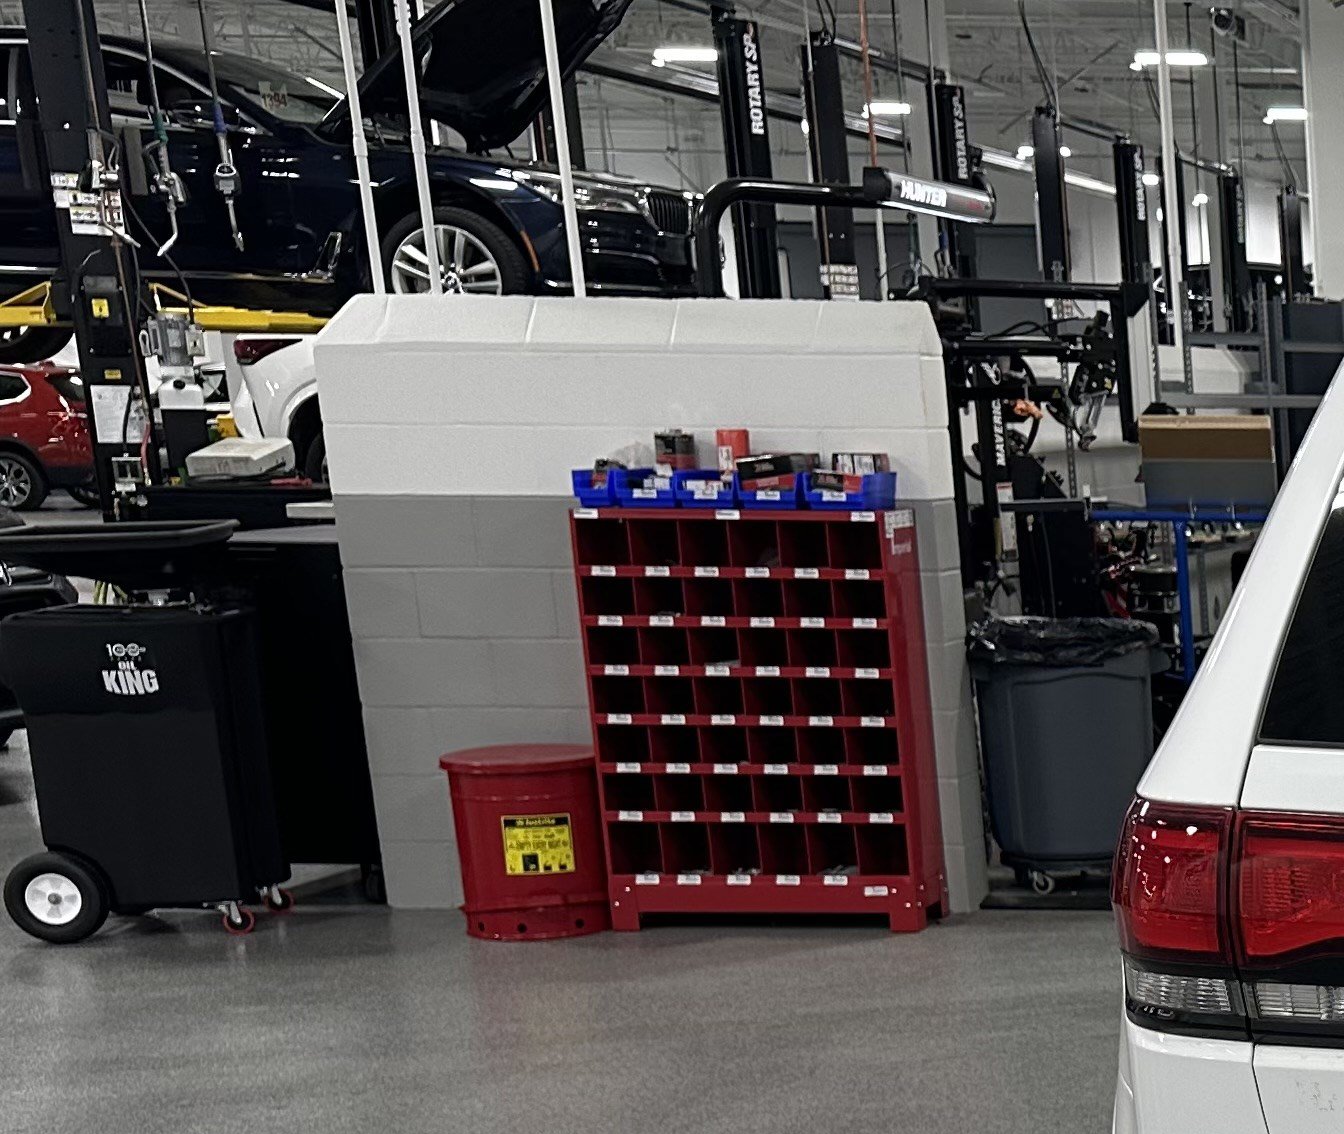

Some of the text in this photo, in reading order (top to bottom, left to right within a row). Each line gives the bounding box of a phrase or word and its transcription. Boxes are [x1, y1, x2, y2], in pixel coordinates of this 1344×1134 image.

[746, 61, 765, 135] ROTARY
[954, 118, 969, 180] ROTARY
[900, 179, 948, 208] HUNTER
[991, 398, 1007, 467] MAVERIC
[102, 669, 159, 695] KING
[118, 660, 137, 671] OIL
